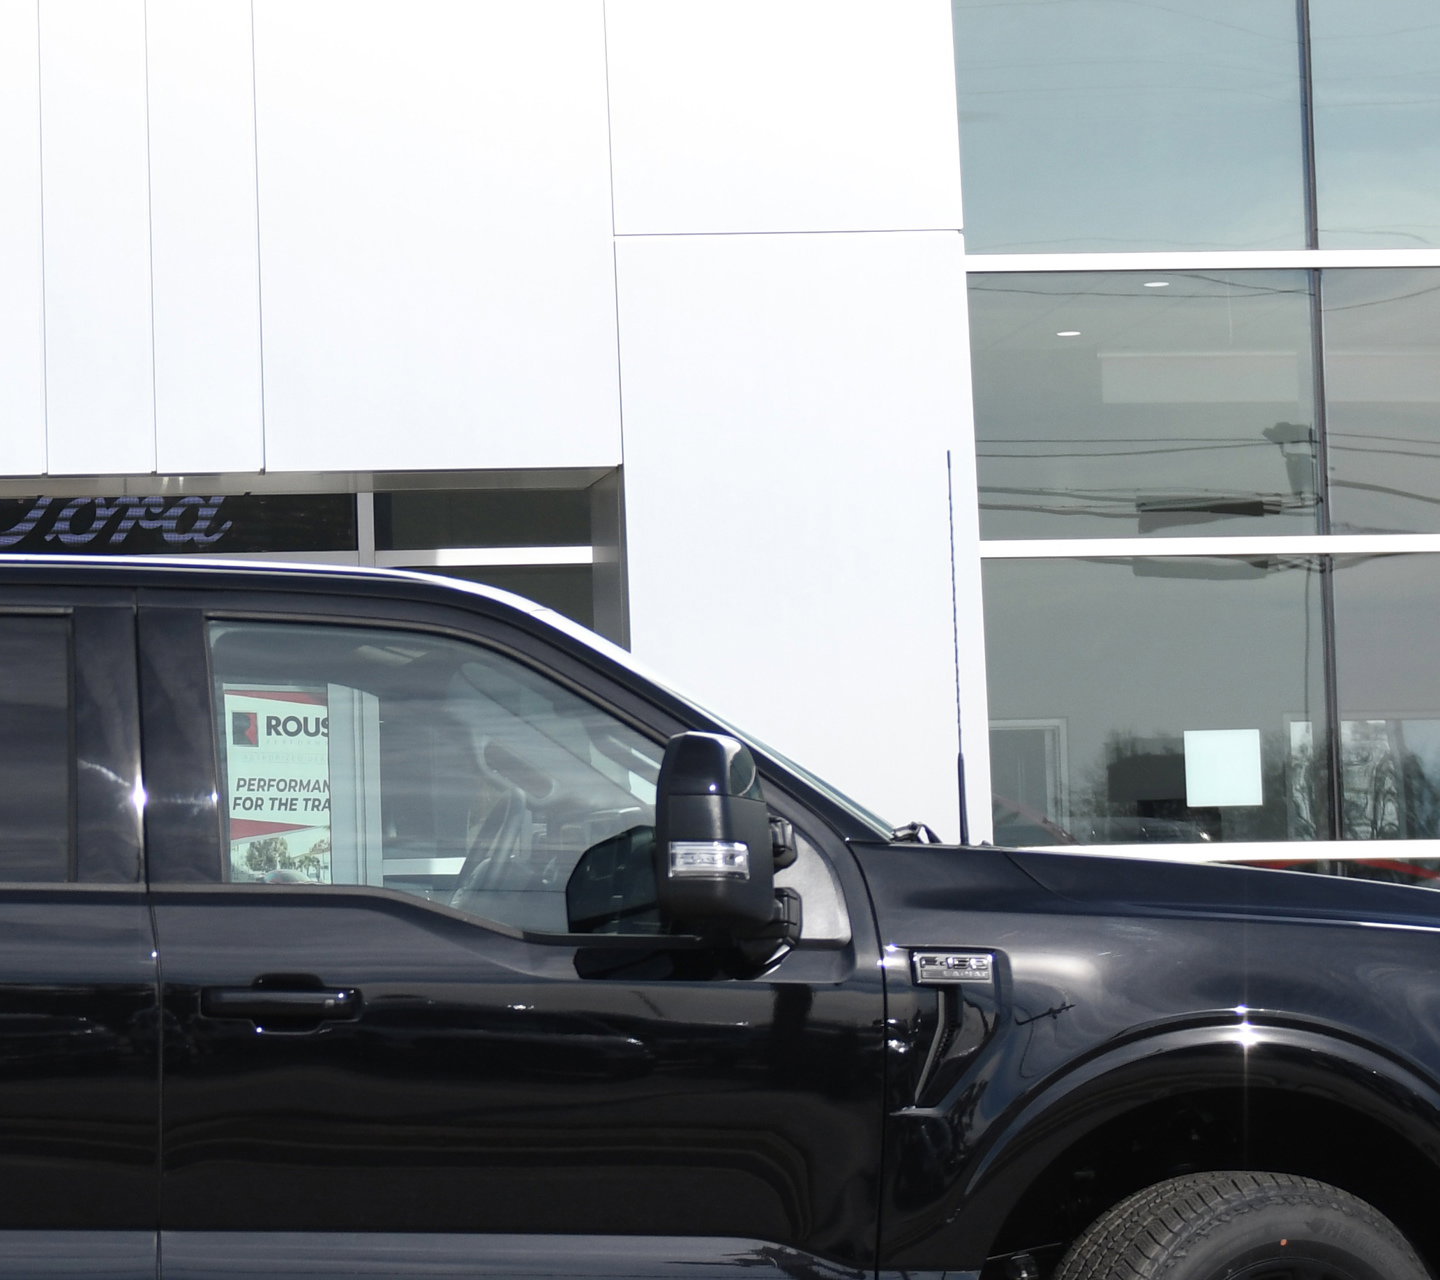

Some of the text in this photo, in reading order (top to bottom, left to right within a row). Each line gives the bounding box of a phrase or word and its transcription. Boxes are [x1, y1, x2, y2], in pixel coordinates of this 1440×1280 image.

[266, 715, 329, 738] ROUS
[236, 777, 330, 793] PERFORMAN
[232, 796, 330, 813] FOR THE TRA
